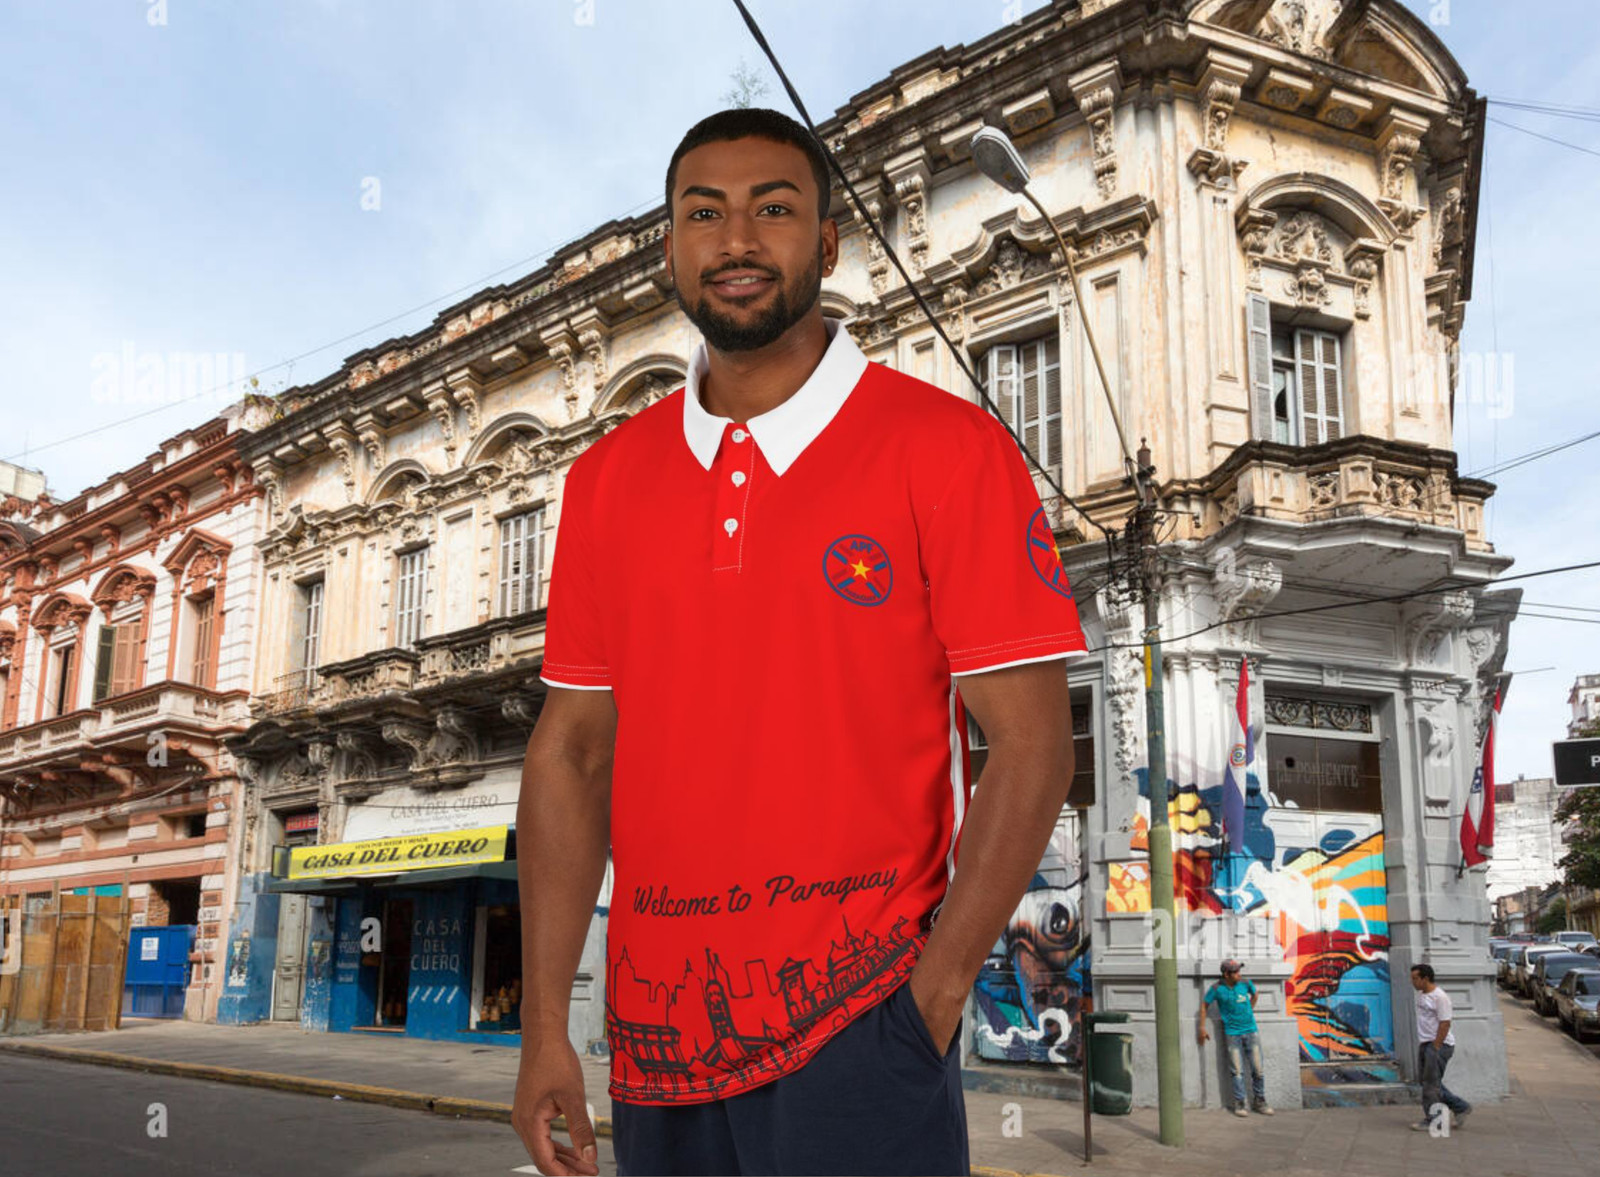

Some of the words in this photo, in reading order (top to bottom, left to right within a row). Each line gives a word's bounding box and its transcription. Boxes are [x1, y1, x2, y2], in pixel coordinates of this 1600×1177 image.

[302, 851, 352, 869] CASA
[358, 847, 402, 865] DEL
[407, 837, 489, 861] CUERO
[633, 885, 722, 917] Welcome
[728, 884, 752, 913] to
[765, 867, 899, 908] Paraguay
[413, 918, 461, 936] CASA
[423, 938, 447, 953] DEL
